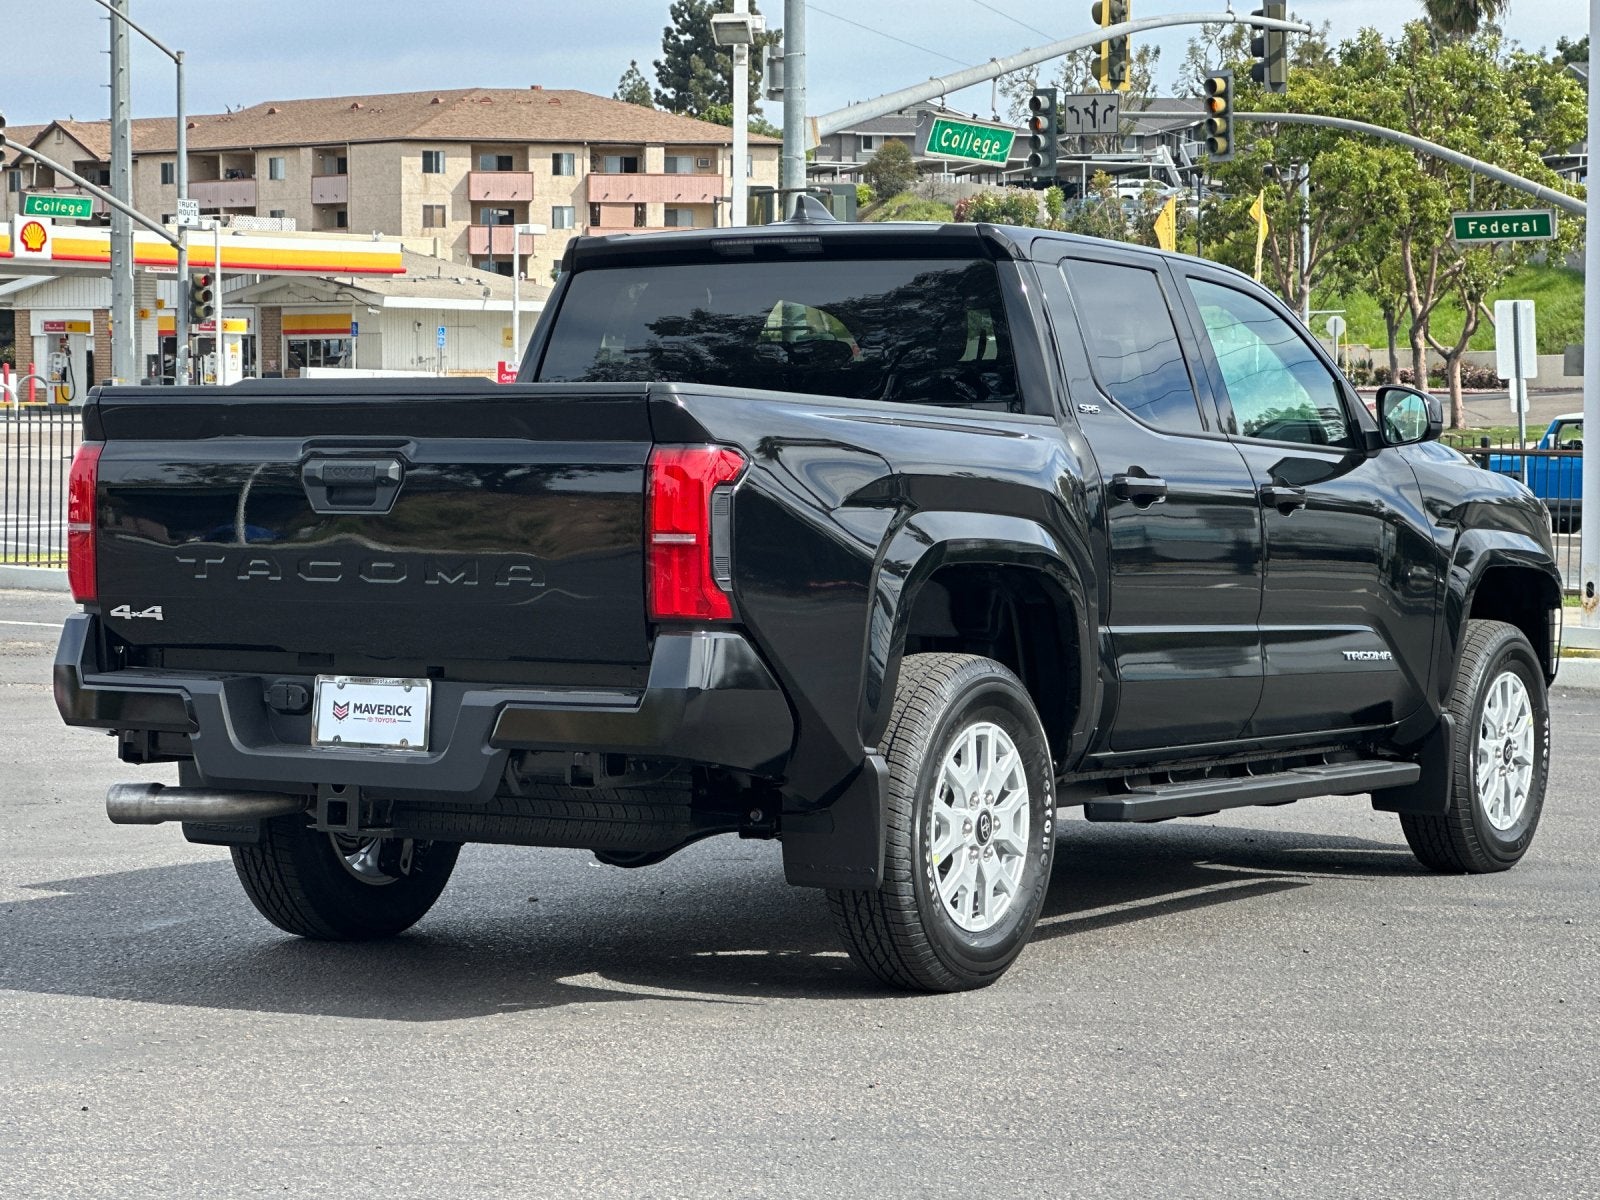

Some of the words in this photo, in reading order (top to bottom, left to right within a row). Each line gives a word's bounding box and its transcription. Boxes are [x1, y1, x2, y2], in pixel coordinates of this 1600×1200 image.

[941, 128, 1001, 159] College
[34, 200, 83, 216] College
[179, 200, 198, 208] TRUCK
[179, 209, 198, 217] ROUTE
[1468, 219, 1538, 235] Federal
[1079, 403, 1101, 414] SR5
[325, 467, 372, 479] TOYOTA
[175, 554, 546, 588] TACOMA
[1342, 650, 1393, 661] TACOMA
[353, 702, 413, 717] MAVERICK
[374, 716, 397, 724] TOYOTA
